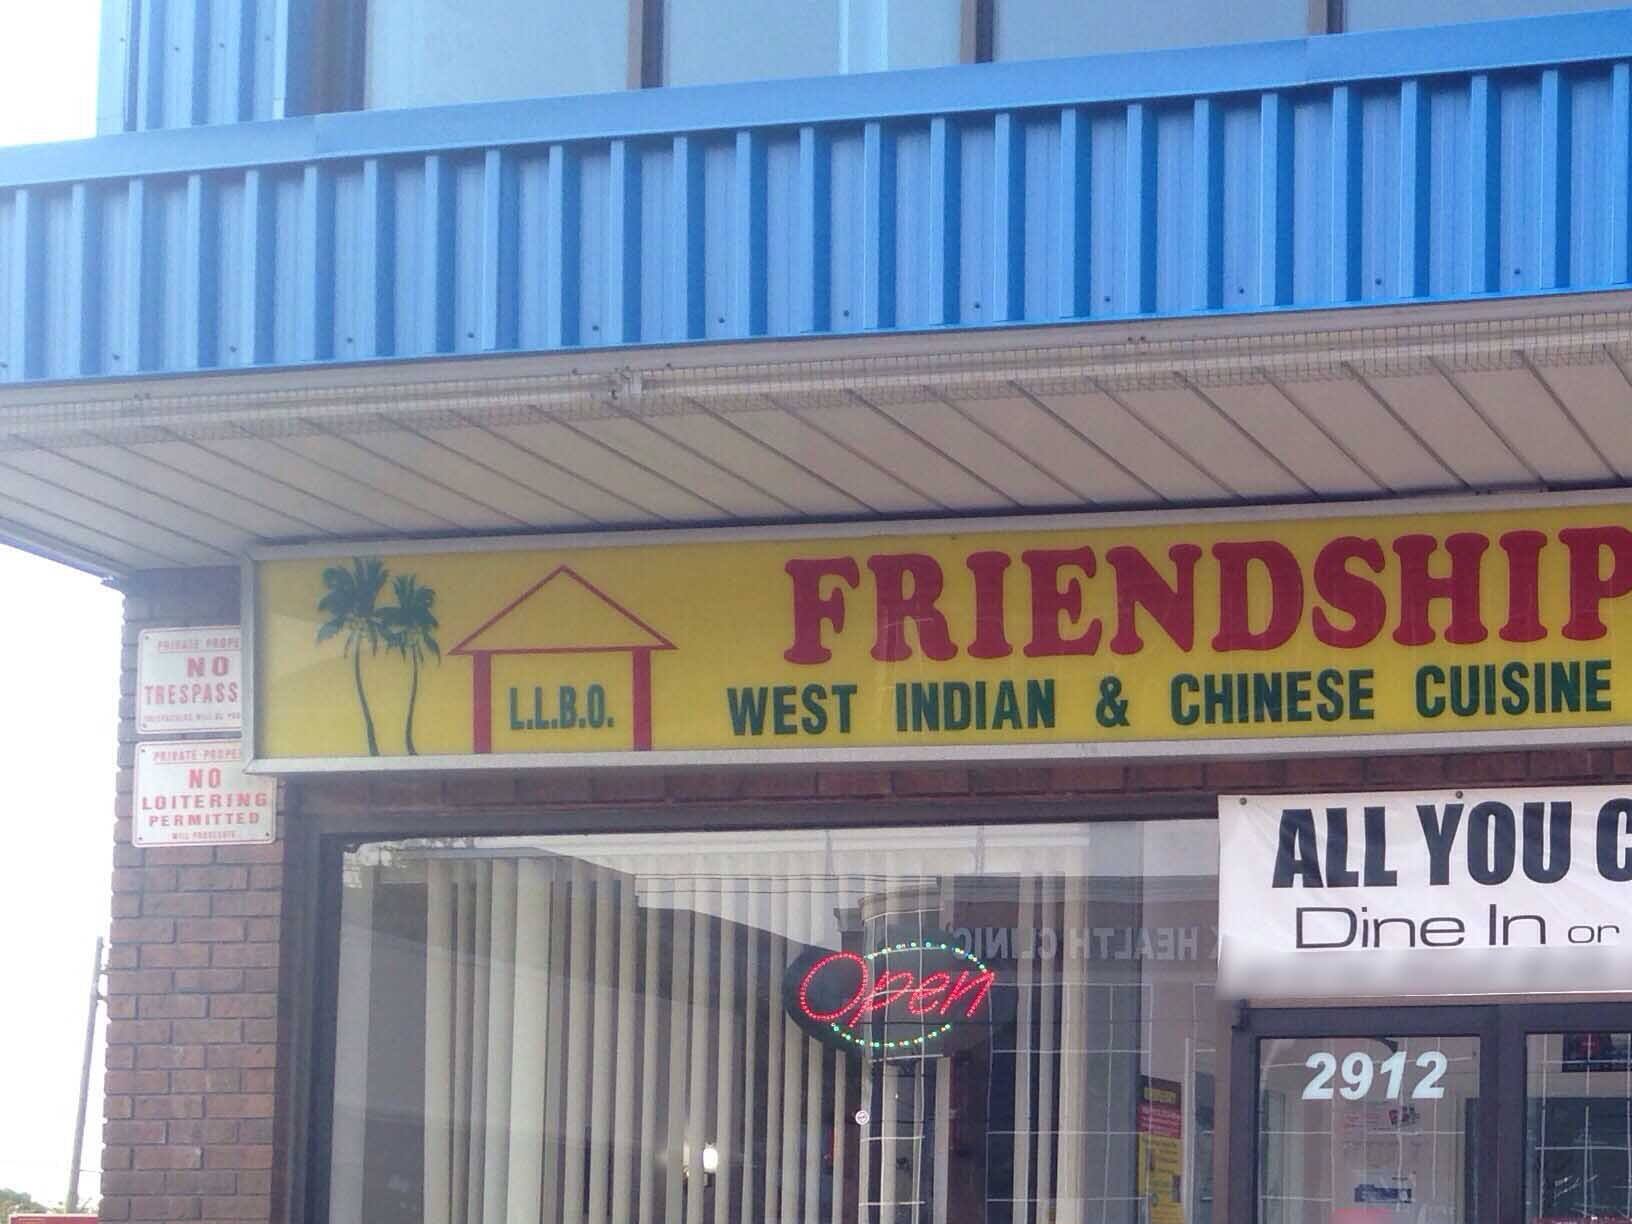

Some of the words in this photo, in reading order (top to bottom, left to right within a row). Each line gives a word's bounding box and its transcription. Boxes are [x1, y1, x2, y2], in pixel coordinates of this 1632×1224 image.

[187, 656, 229, 678] NO
[144, 681, 239, 705] TRESPASS
[509, 683, 615, 730] L.L.B.O.
[726, 683, 857, 737] WEST
[895, 678, 1056, 733] INDIAN
[1095, 676, 1131, 728] &
[1170, 668, 1376, 727] CHINESE
[1415, 659, 1613, 719] CUISINE
[189, 768, 221, 788] NO
[142, 793, 267, 810] LOITERING
[149, 812, 259, 826] PERMITTED
[1271, 807, 1399, 889] ALL
[1415, 799, 1572, 884] YOU
[1295, 905, 1465, 949] Dine
[1489, 904, 1547, 946] In
[1567, 921, 1620, 944] or
[798, 951, 995, 1028] Open
[1301, 1051, 1449, 1101] 2912
